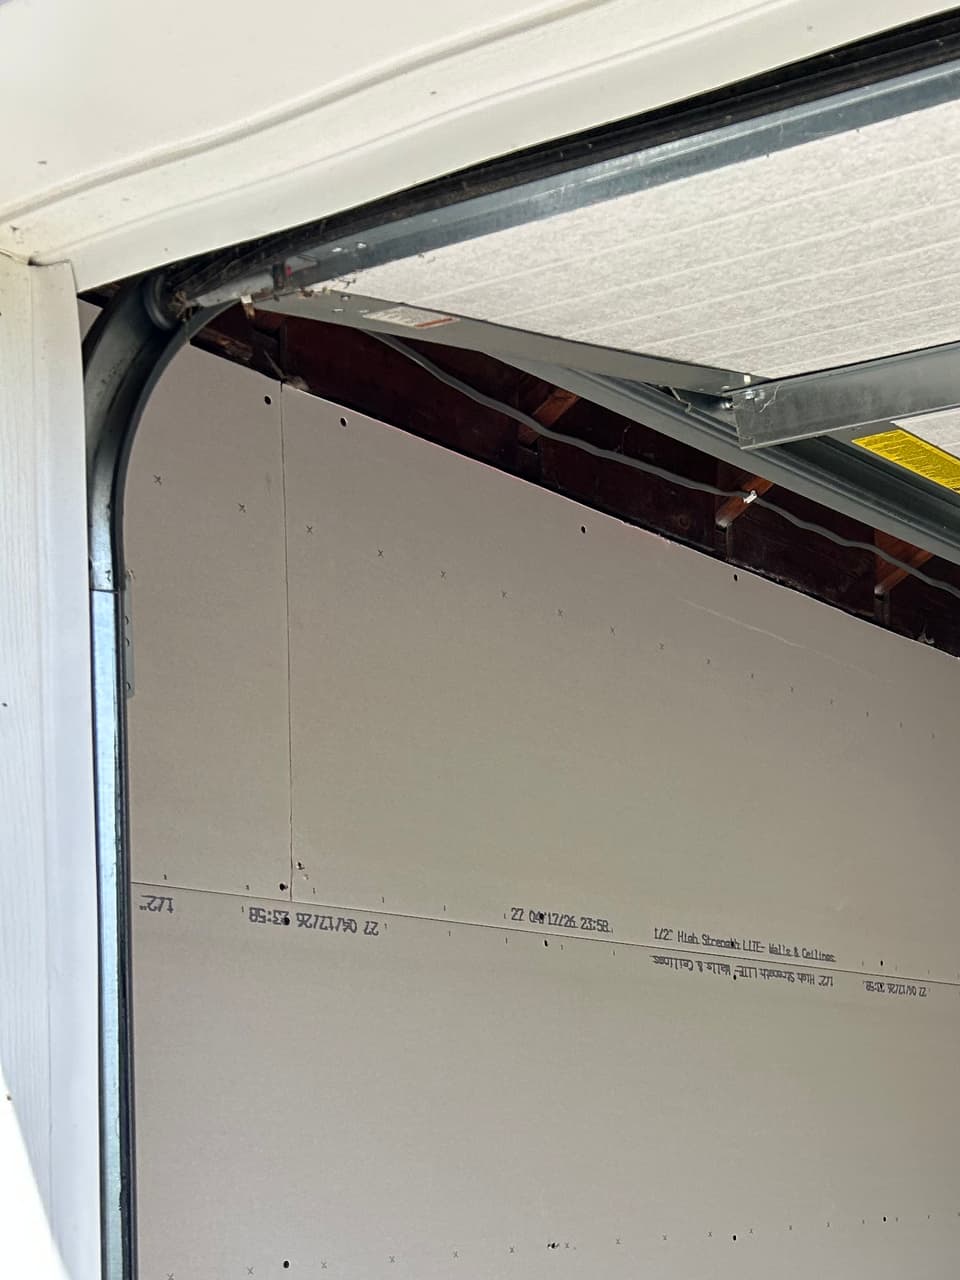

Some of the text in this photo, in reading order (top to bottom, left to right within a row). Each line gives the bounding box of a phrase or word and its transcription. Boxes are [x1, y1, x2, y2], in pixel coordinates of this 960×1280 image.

[295, 912, 358, 934] 04/17/26
[363, 920, 380, 936] 27
[511, 907, 524, 921] 27
[580, 917, 610, 932] 23:58
[677, 931, 700, 945] High
[793, 947, 801, 958] &
[695, 960, 704, 973] &
